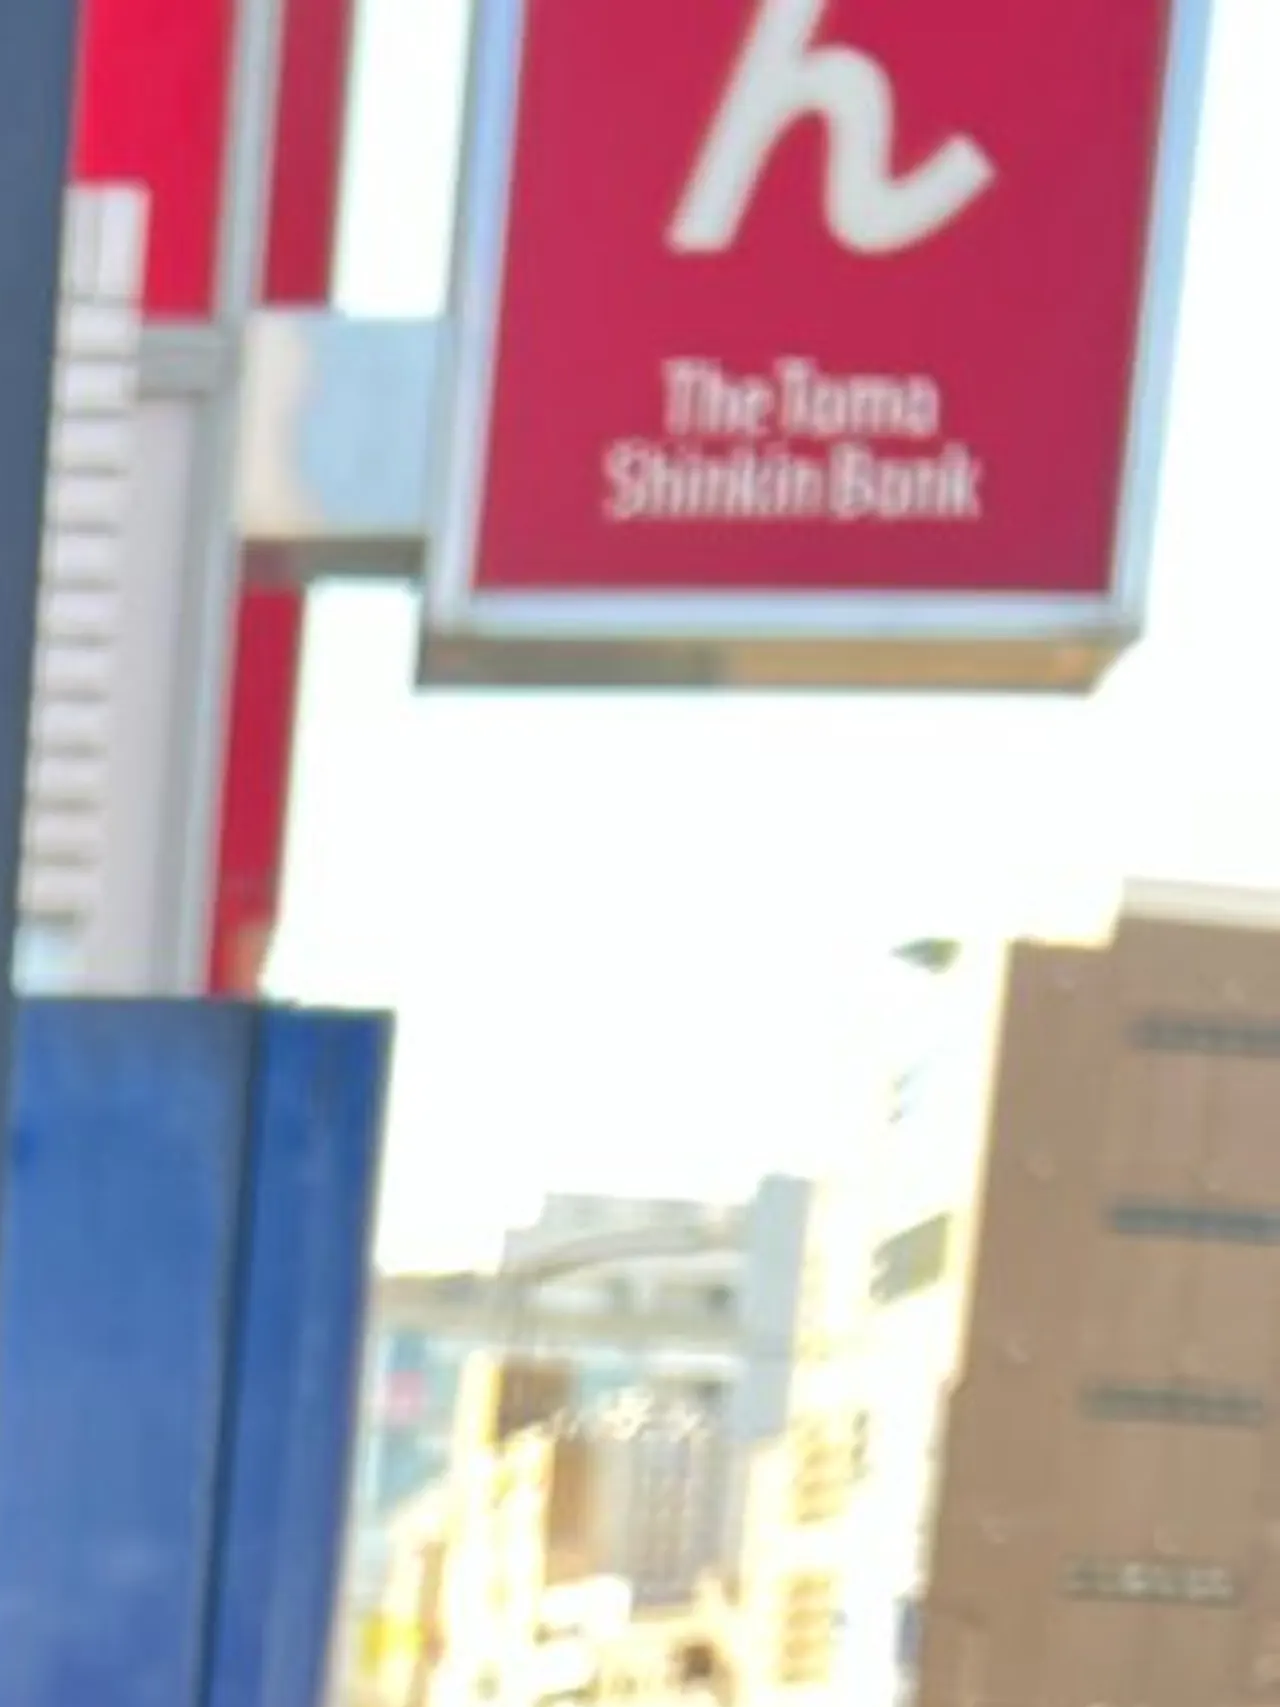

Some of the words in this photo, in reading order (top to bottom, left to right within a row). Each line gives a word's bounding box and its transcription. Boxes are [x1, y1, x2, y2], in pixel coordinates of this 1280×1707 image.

[662, 358, 772, 434] The
[775, 357, 940, 436] Tama
[606, 440, 824, 520] Shinkin
[830, 443, 982, 520] Bank
